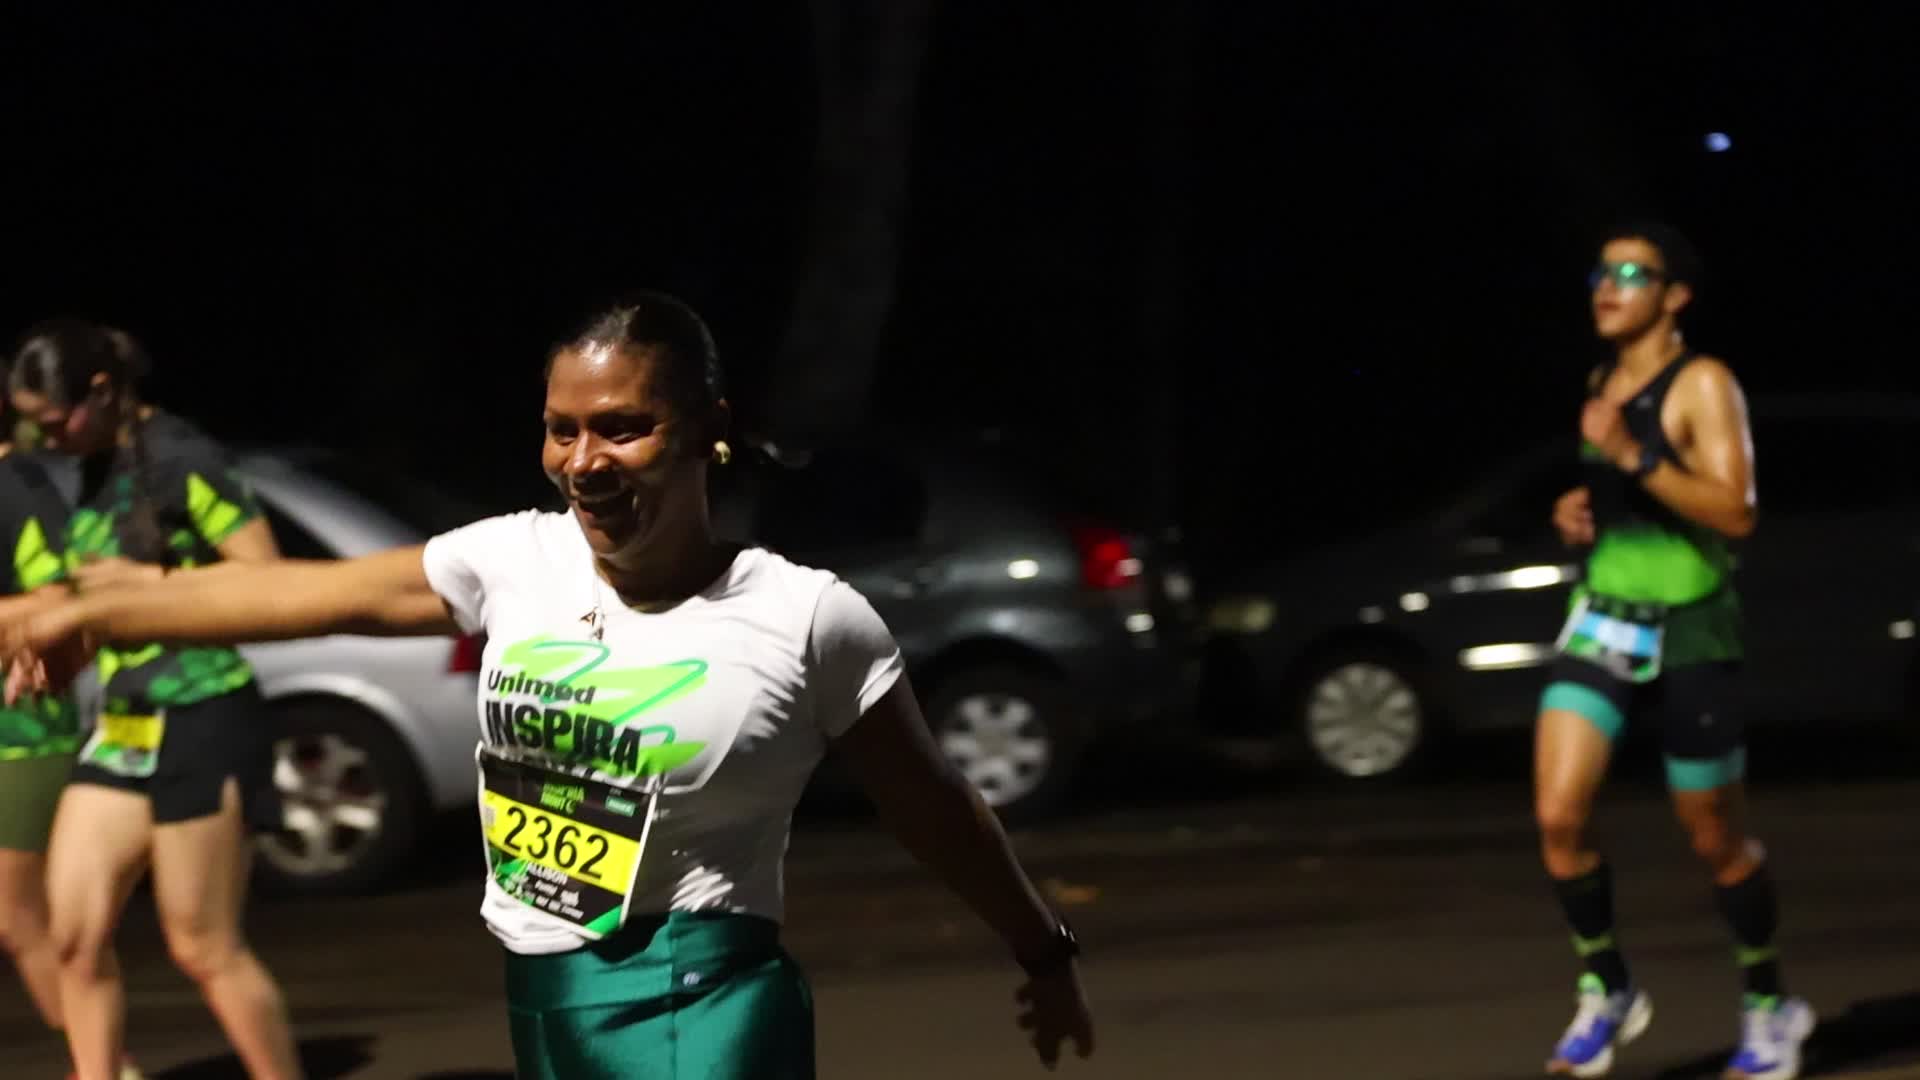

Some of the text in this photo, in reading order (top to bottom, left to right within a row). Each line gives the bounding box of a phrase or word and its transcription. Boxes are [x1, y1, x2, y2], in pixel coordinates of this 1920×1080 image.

[488, 669, 596, 705] Unimed
[486, 701, 641, 774] INSPIRA
[503, 805, 609, 880] 2362
